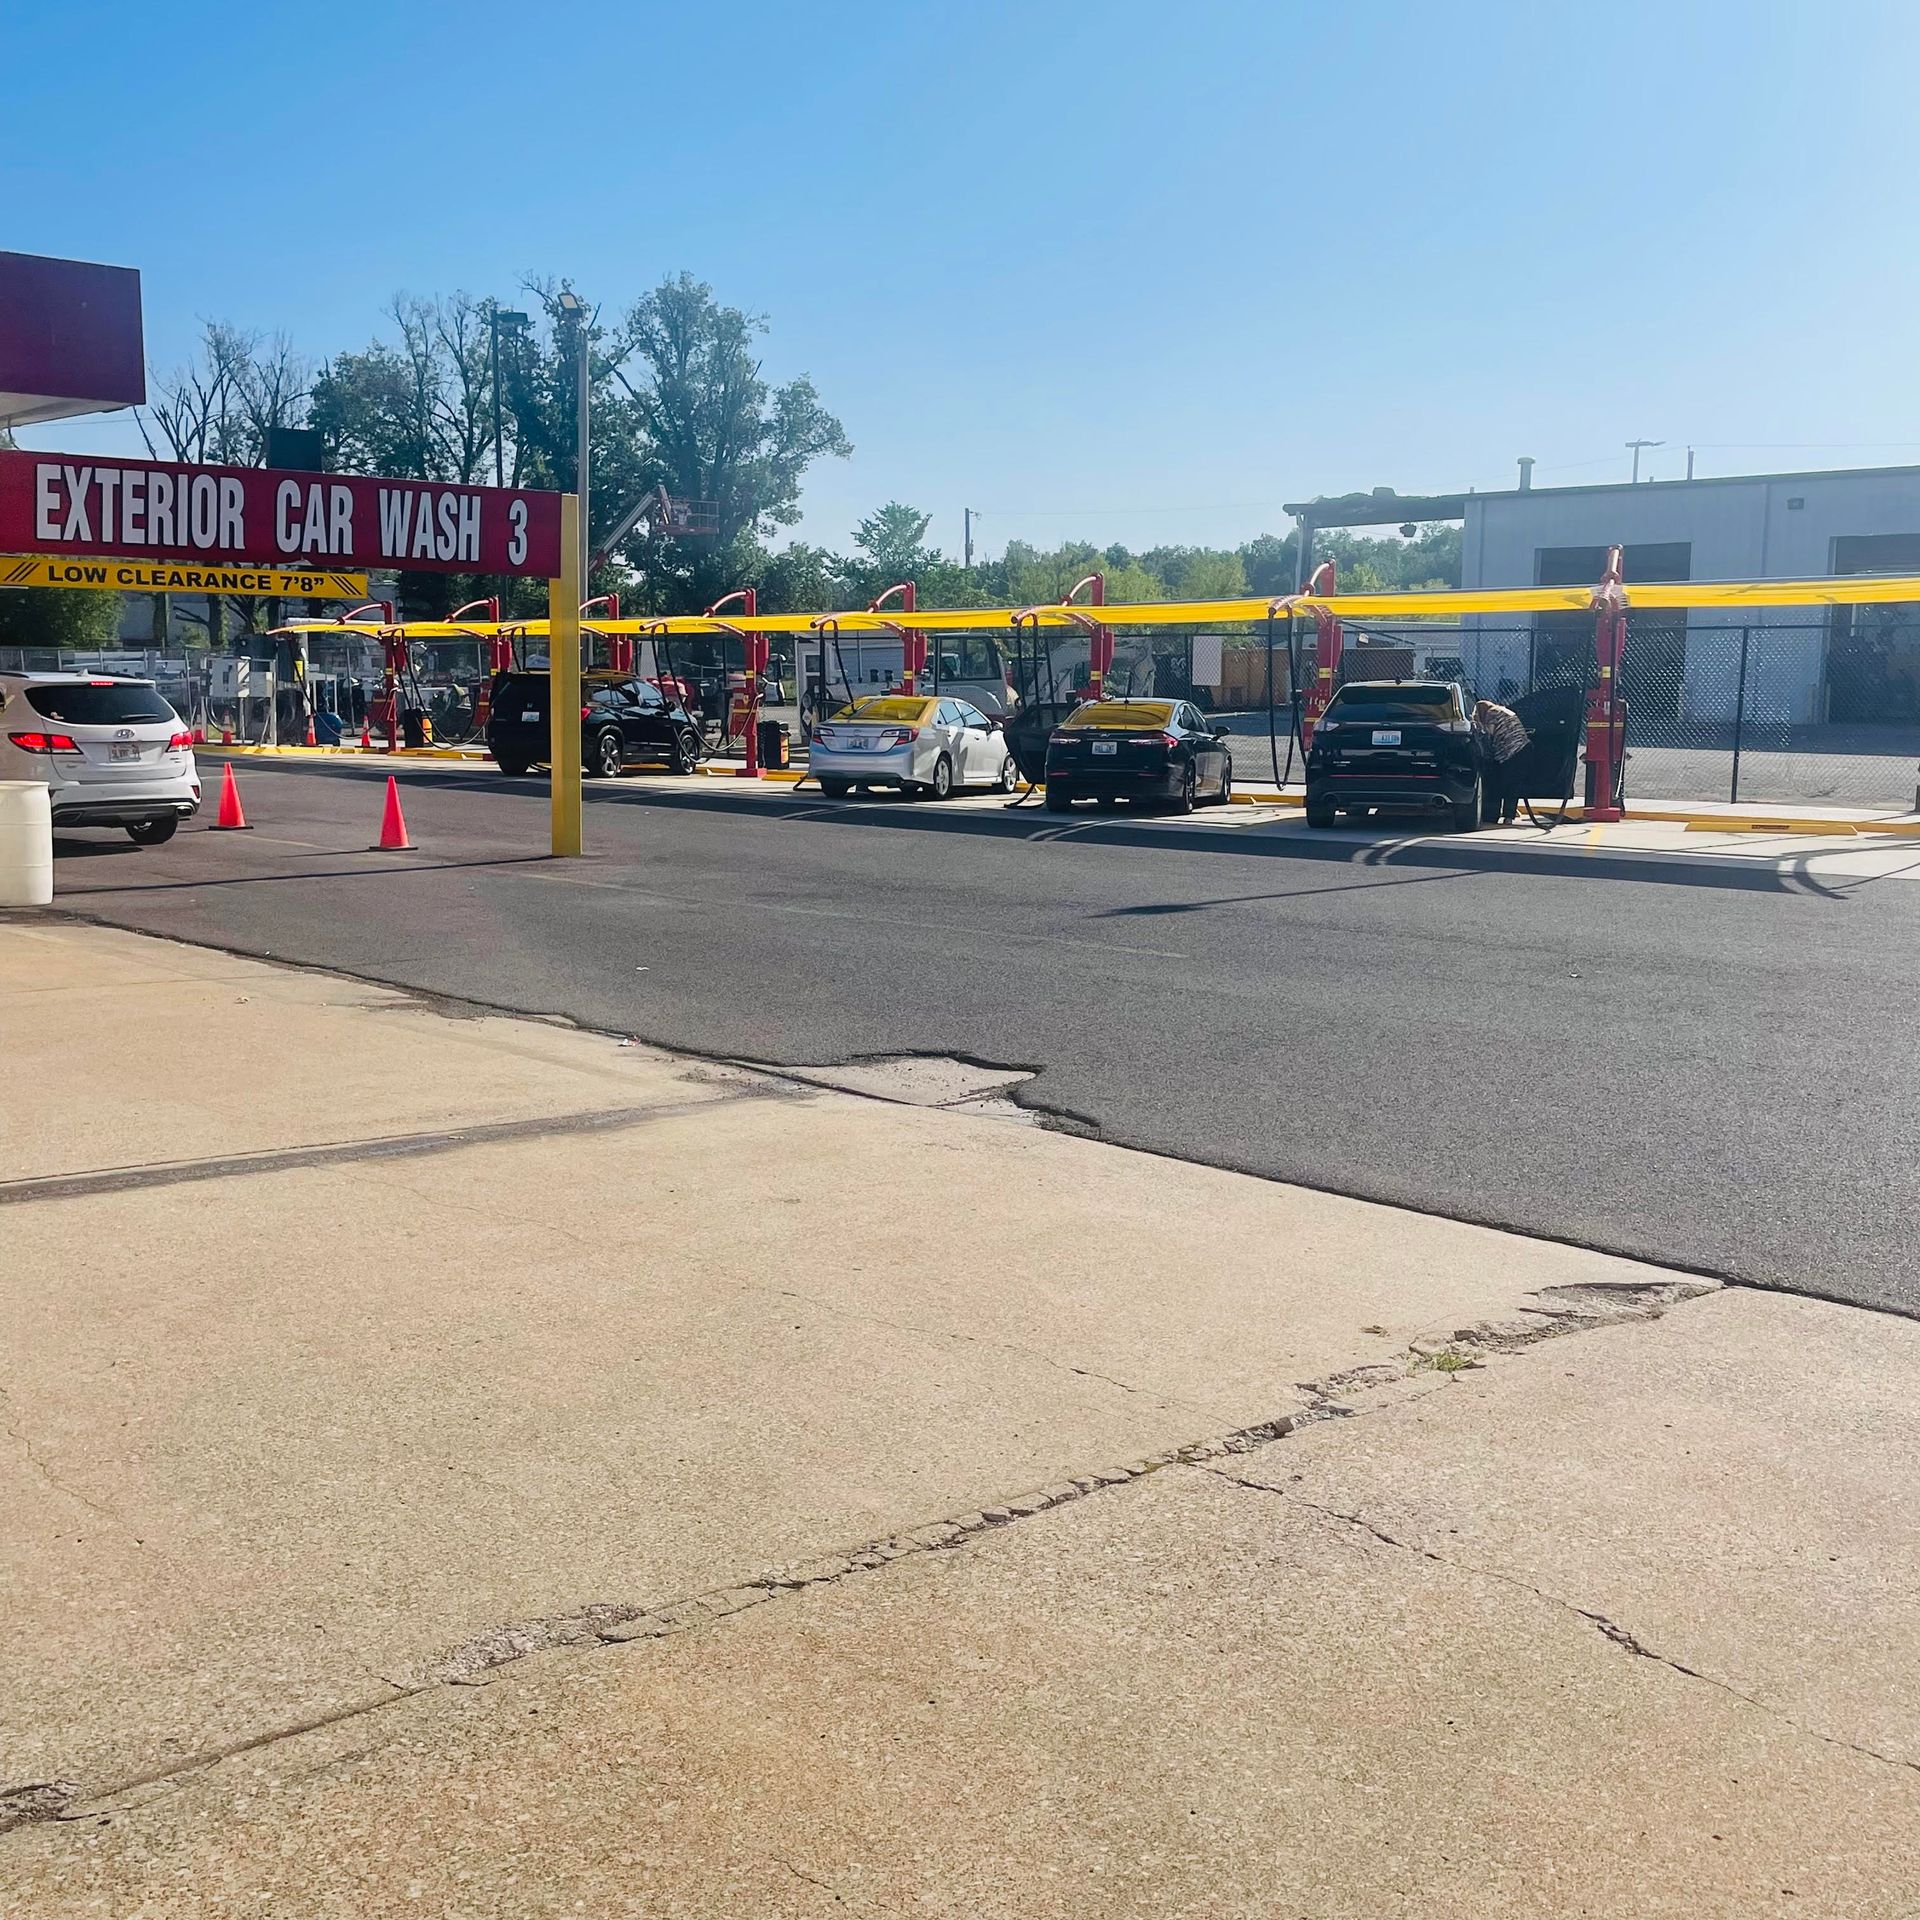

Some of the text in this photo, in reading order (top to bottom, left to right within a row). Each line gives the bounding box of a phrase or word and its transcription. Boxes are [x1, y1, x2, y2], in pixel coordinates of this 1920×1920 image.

[36, 463, 529, 567] EXTERIOR CAR WASH 3
[48, 565, 107, 583] LOW
[116, 568, 272, 591] CLEARANCE
